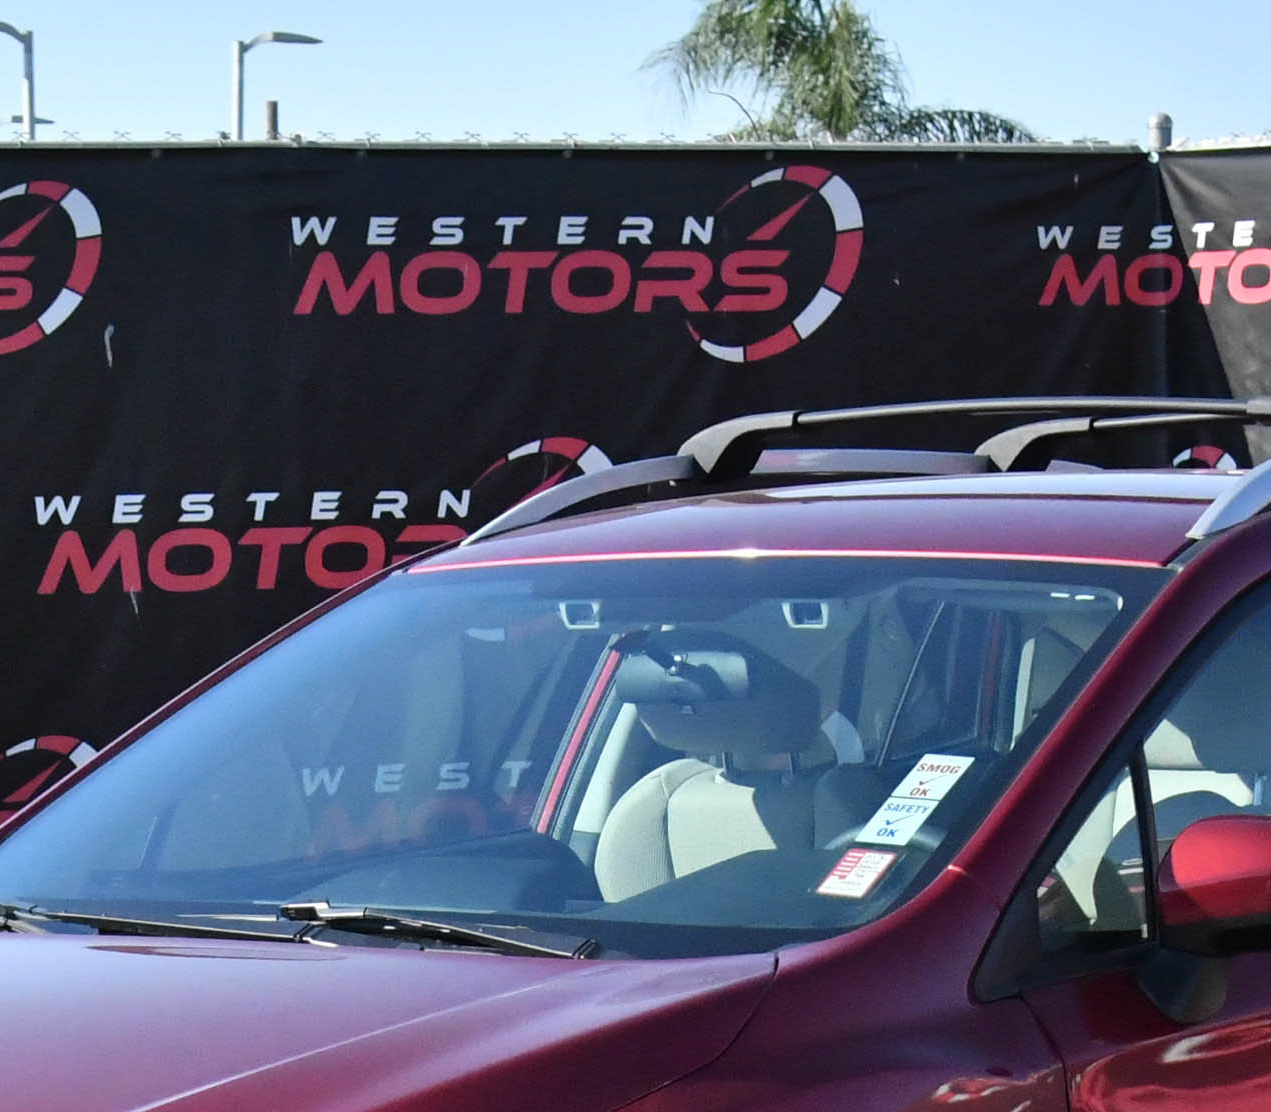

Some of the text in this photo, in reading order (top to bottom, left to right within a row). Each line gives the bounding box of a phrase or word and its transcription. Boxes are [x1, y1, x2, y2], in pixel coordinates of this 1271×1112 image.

[291, 215, 715, 246] WESTERN
[292, 249, 791, 316] MOTORS
[34, 488, 471, 525] WESTERN
[37, 524, 468, 595] MOTO
[301, 760, 533, 798] WEST
[916, 763, 962, 774] SMOG
[909, 787, 932, 797] OK
[884, 803, 931, 815] SAFETY
[876, 828, 898, 838] OK
